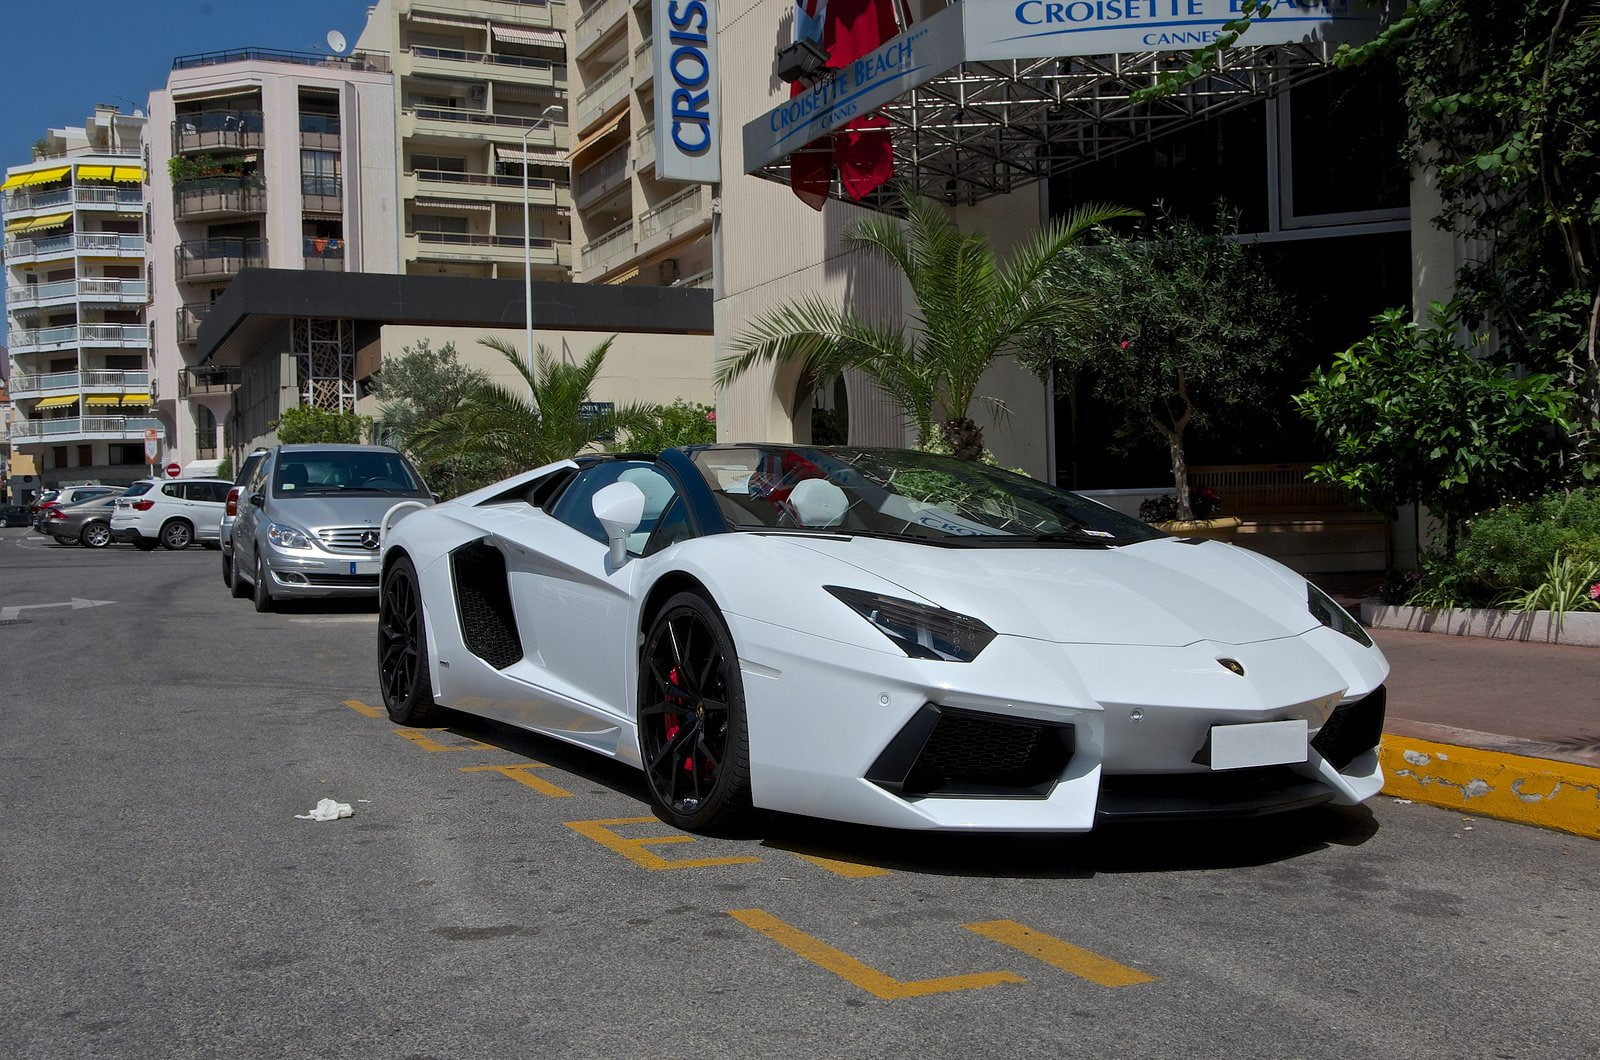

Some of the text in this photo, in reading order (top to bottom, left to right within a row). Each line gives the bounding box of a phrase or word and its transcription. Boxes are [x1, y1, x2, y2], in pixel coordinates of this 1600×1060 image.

[1015, 0, 1203, 25] CROISETTE
[1142, 29, 1222, 46] CANNES
[854, 36, 913, 88] BEACH
[821, 102, 858, 129] CANNES
